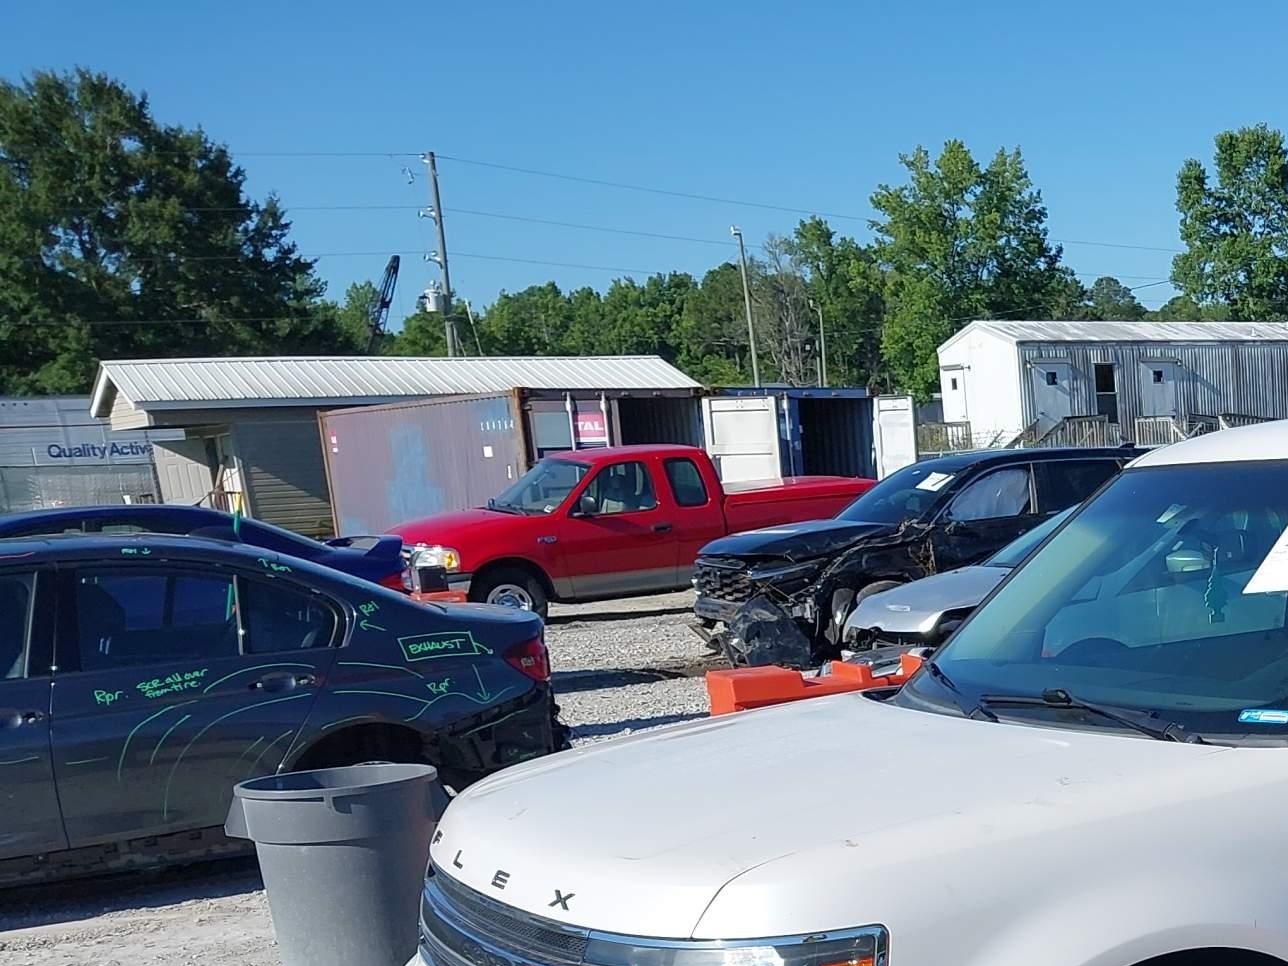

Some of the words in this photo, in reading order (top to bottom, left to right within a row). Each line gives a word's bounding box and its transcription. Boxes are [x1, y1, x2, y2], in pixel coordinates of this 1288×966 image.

[48, 443, 107, 459] Quality
[408, 638, 466, 654] EXHAUST
[432, 830, 576, 911] FLEX
